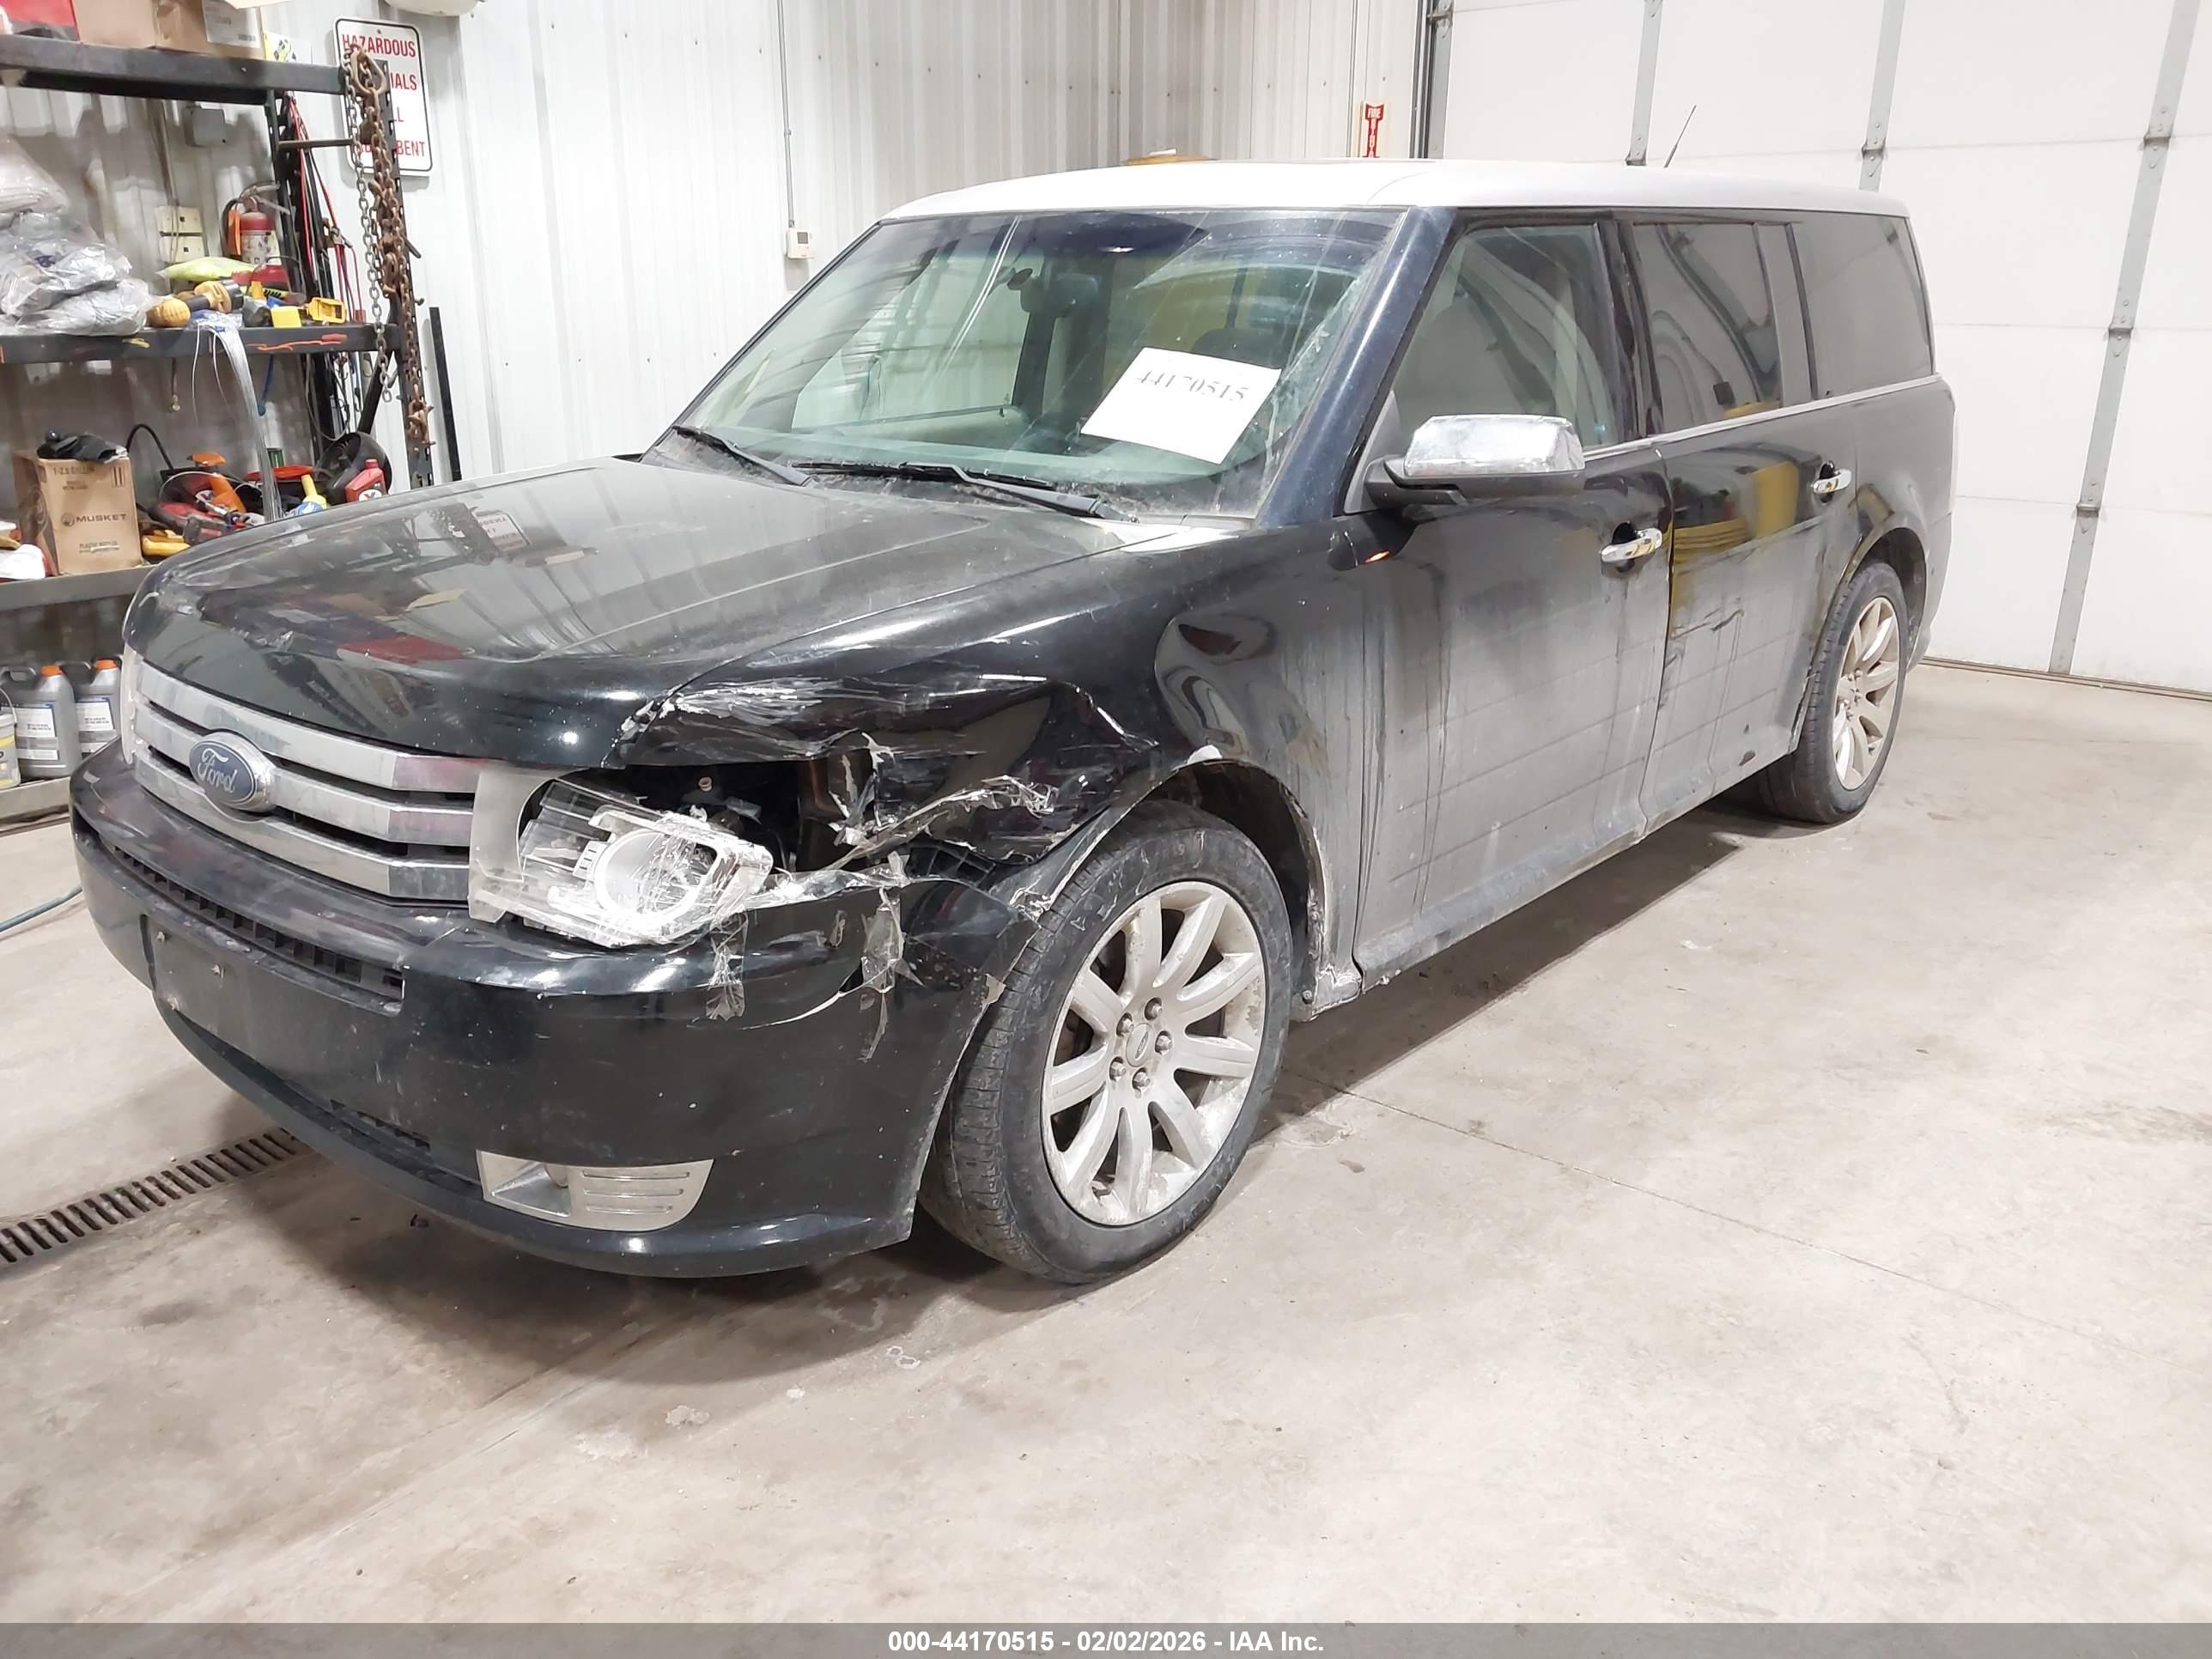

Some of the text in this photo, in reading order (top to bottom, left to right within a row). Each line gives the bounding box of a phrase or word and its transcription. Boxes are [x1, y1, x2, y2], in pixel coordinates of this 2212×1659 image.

[342, 33, 416, 58] HAZARDOUS
[390, 72, 417, 91] IALS
[76, 514, 127, 523] MUSKET
[197, 747, 238, 793] Ford
